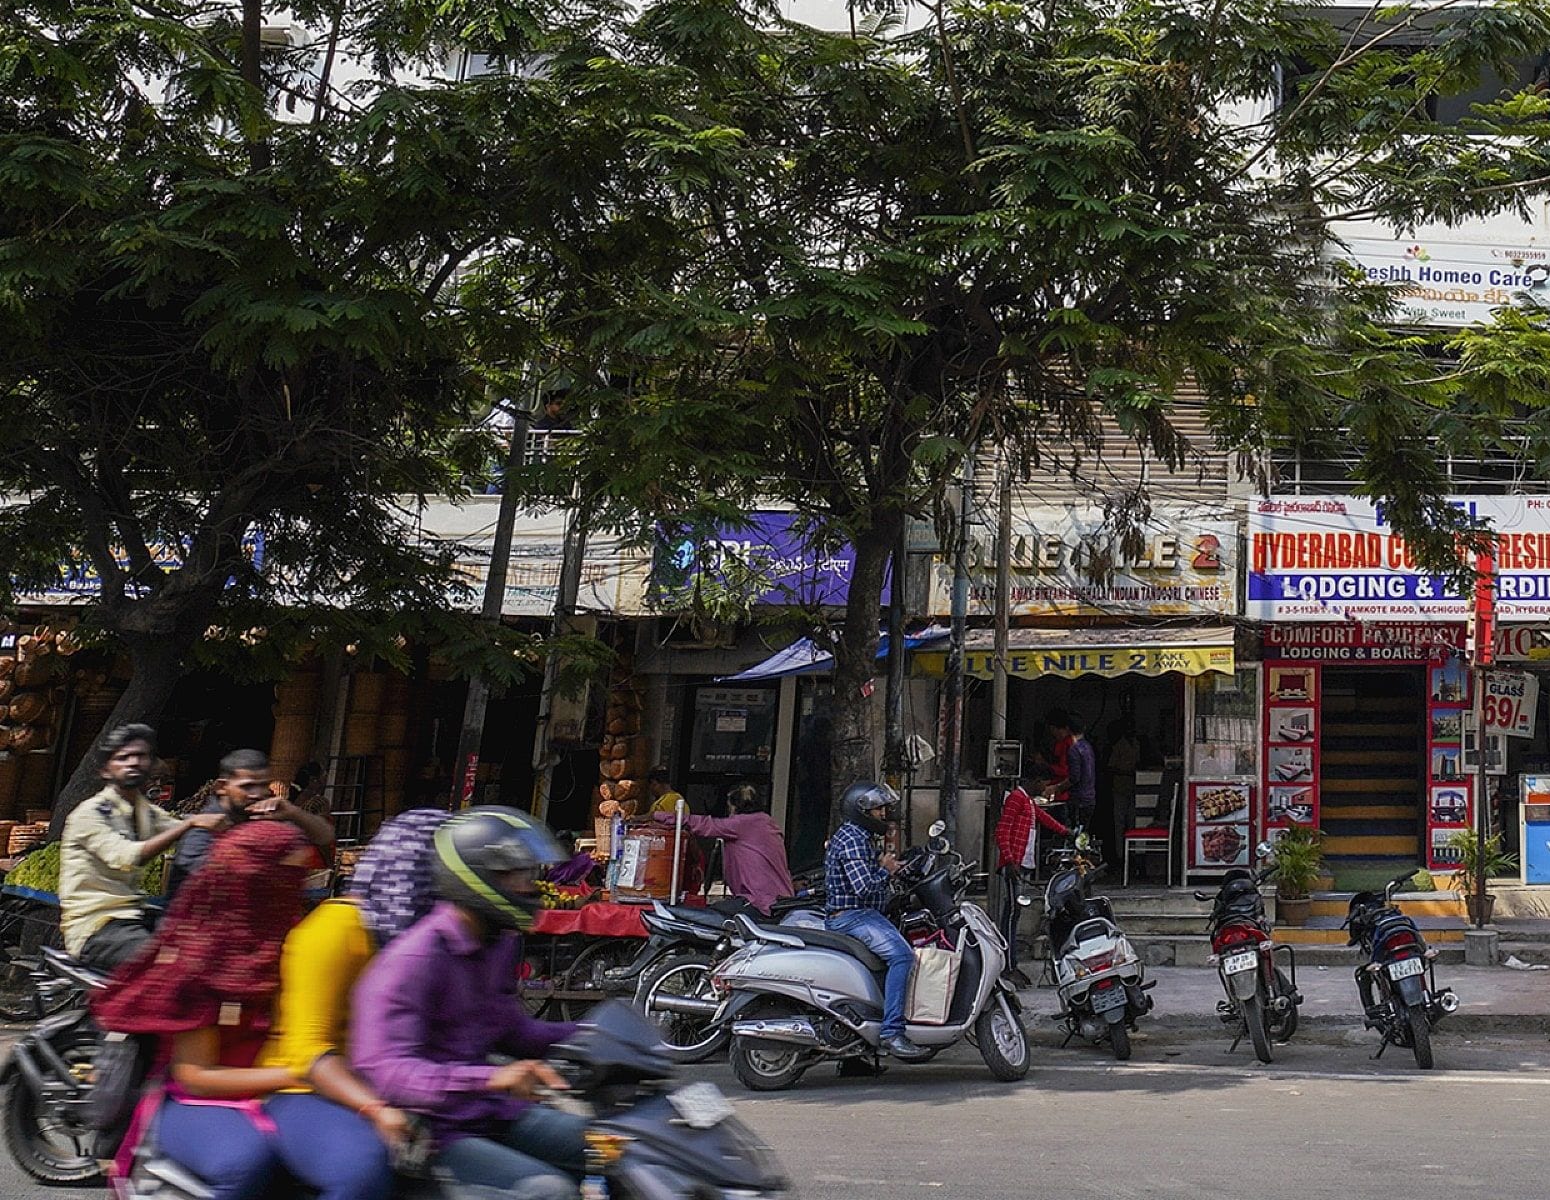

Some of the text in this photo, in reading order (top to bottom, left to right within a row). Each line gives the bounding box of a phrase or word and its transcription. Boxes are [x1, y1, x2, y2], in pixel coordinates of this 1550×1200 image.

[1419, 266, 1482, 285] Homeo
[1489, 269, 1533, 287] Care
[1431, 308, 1466, 319] Sweet
[1193, 534, 1221, 569] 2
[1253, 532, 1382, 570] HYDERABAD
[1283, 576, 1406, 599] LODGING
[1415, 576, 1434, 598] &
[1344, 605, 1390, 615] RAMKOTE
[1420, 605, 1470, 615] KACHIGUD
[1270, 626, 1354, 644] COMFORT
[1044, 654, 1115, 671] NILE
[1129, 654, 1147, 671] 2
[1153, 653, 1185, 661] TAKE
[1281, 647, 1351, 659] LODGING
[1355, 647, 1366, 659] &
[1153, 660, 1191, 669] AWAY
[1489, 683, 1525, 697] GLASS
